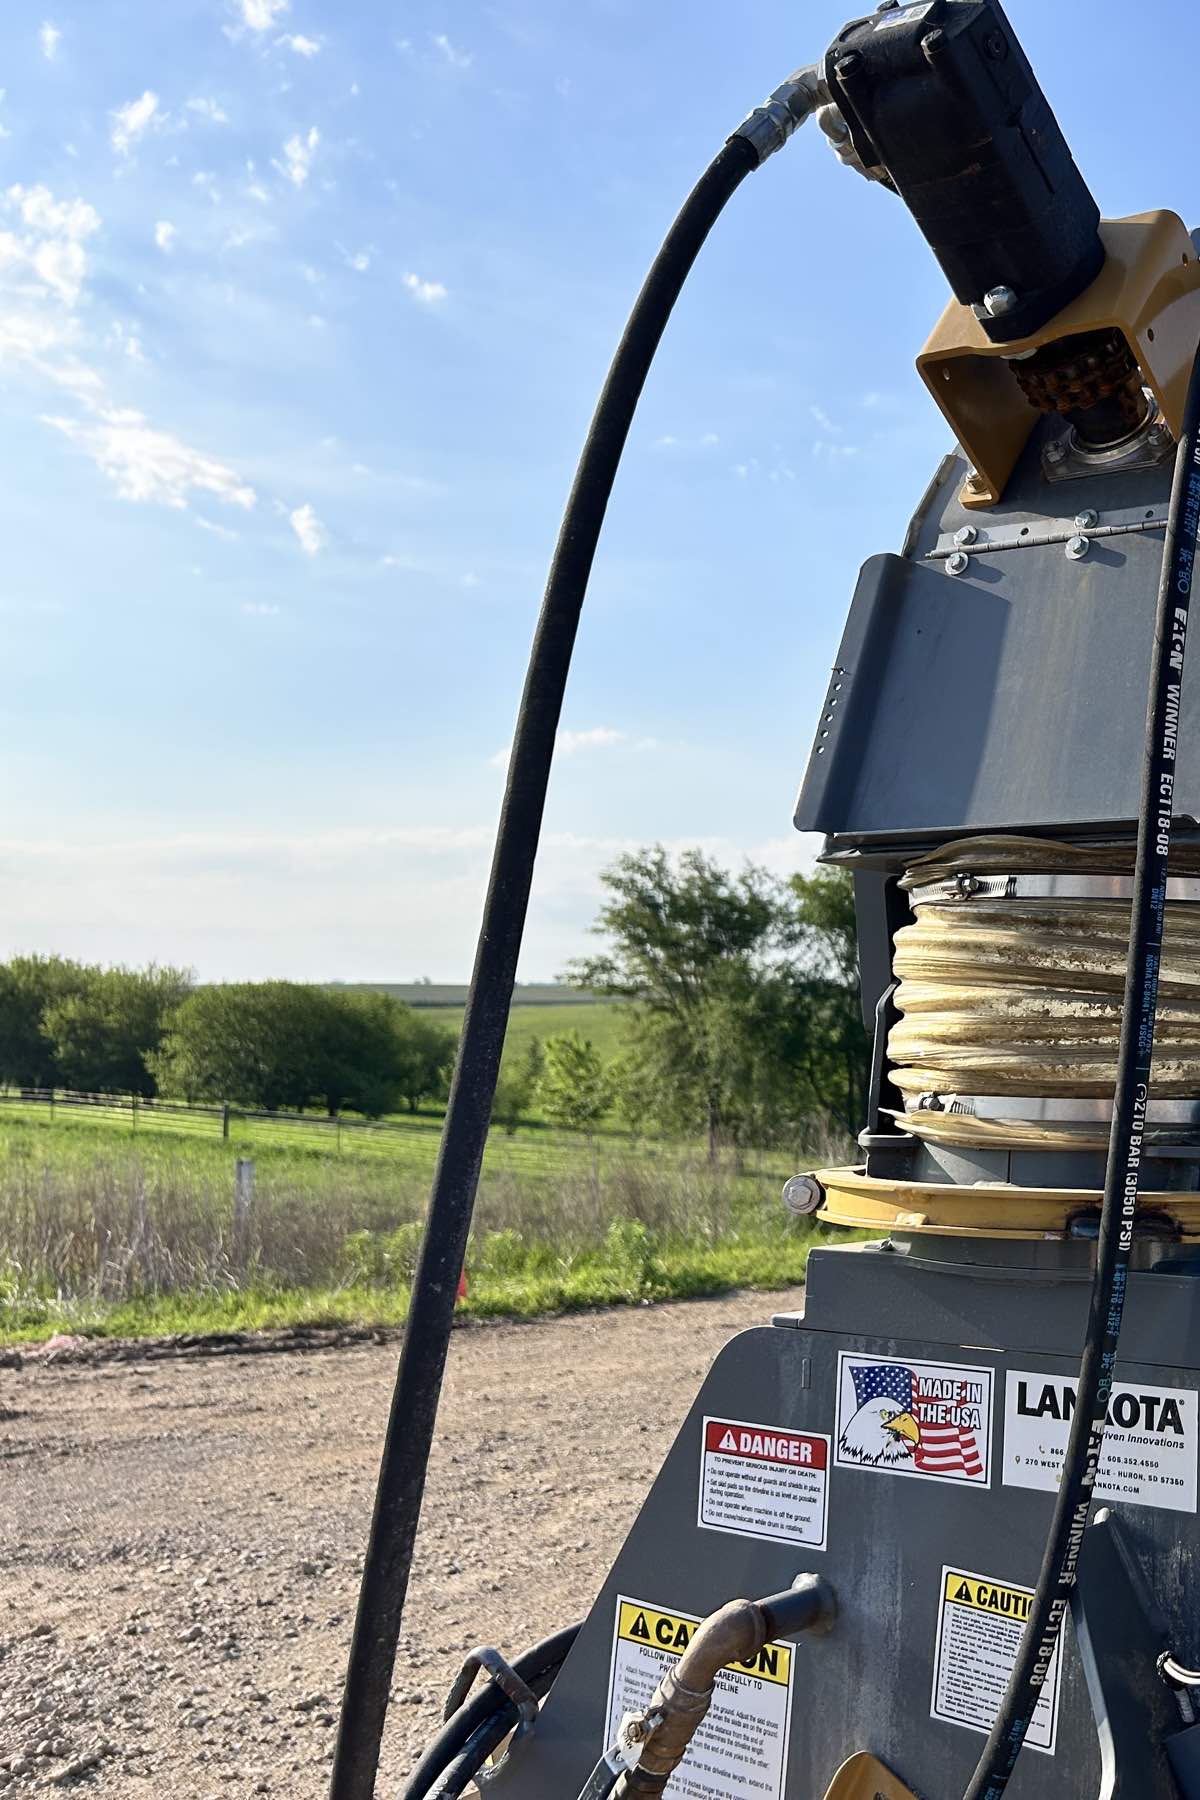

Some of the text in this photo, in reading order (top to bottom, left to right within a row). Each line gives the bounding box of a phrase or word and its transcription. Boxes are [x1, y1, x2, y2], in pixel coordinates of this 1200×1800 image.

[1170, 607, 1186, 669] EATON
[1162, 684, 1180, 759] WINNER
[1153, 772, 1174, 855] EC118-08
[1131, 1101, 1144, 1131] 210
[1127, 1134, 1141, 1168] BAR
[1122, 1171, 1137, 1216] (3050
[1117, 1219, 1133, 1252] PSI)
[918, 1377, 982, 1404] MADE IN
[918, 1403, 982, 1430] THE USA
[739, 1432, 812, 1463] DANGER
[1103, 1430, 1184, 1449] riven Innovations
[722, 1458, 744, 1466] PREVENT
[745, 1461, 767, 1470] SERIOUS
[769, 1465, 787, 1473] INJURY
[1025, 1458, 1059, 1468] 270 WEST
[975, 1584, 1032, 1619] CAUTI
[1027, 1595, 1066, 1689] EC118-08
[639, 1647, 664, 1661] FOLLOW
[753, 1680, 762, 1690] TO
